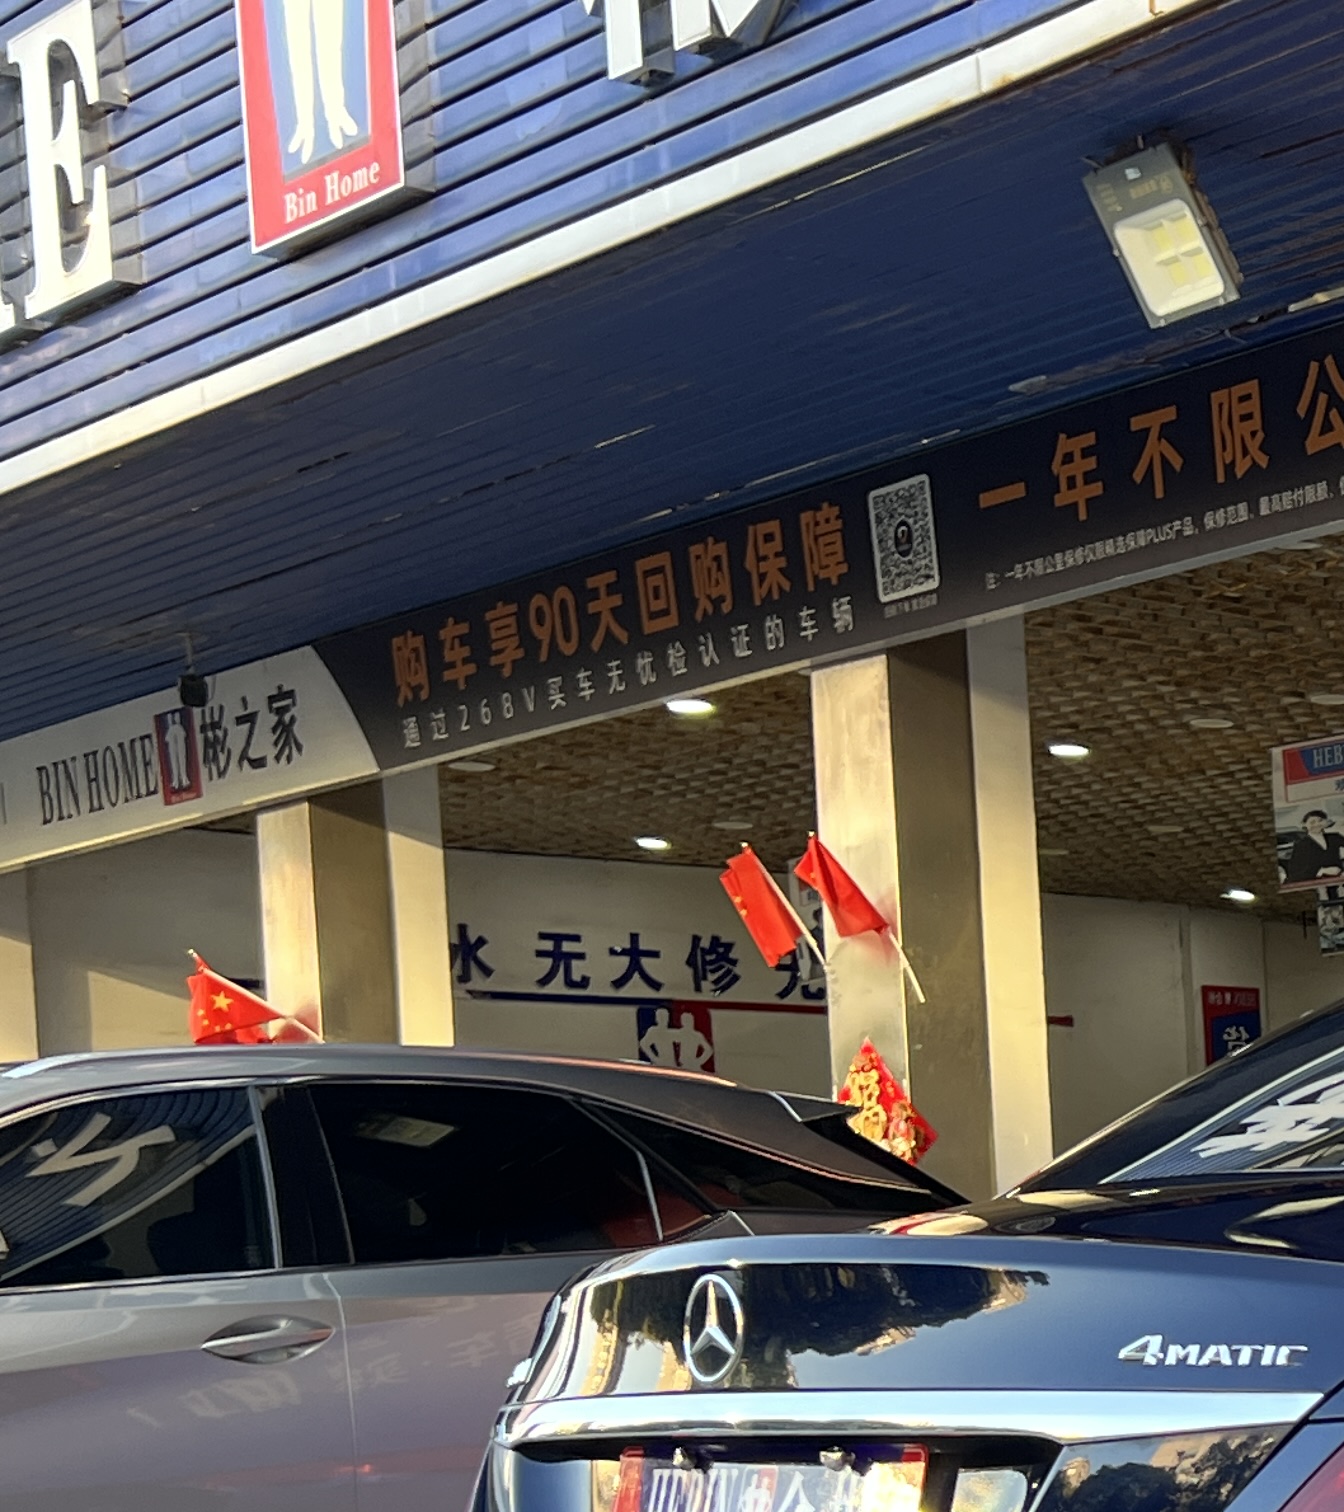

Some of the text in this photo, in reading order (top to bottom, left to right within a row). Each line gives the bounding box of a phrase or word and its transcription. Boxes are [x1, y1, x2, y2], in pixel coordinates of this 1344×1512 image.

[0, 0, 113, 334] E
[284, 161, 381, 224] Bin Home
[391, 503, 851, 708] 购车享90天回购保障
[200, 684, 304, 781] 彬之家
[36, 734, 160, 826] BIN HOME
[1117, 1332, 1309, 1367] 4MATIC
